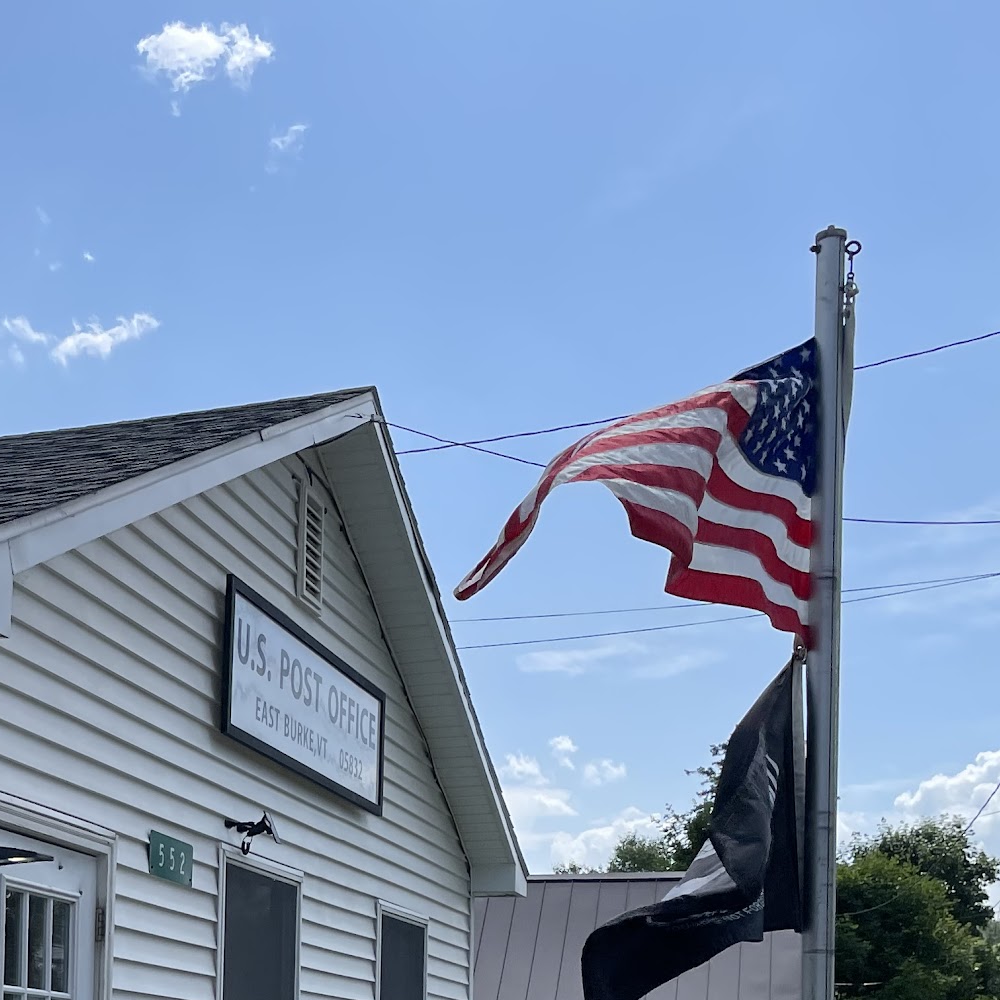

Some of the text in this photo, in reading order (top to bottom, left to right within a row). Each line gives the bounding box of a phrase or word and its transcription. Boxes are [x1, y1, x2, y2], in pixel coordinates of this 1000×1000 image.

[237, 618, 376, 750] U.S. POST OFFICE
[255, 696, 281, 731] EAST
[339, 748, 363, 780] 05832
[158, 843, 185, 875] 552
